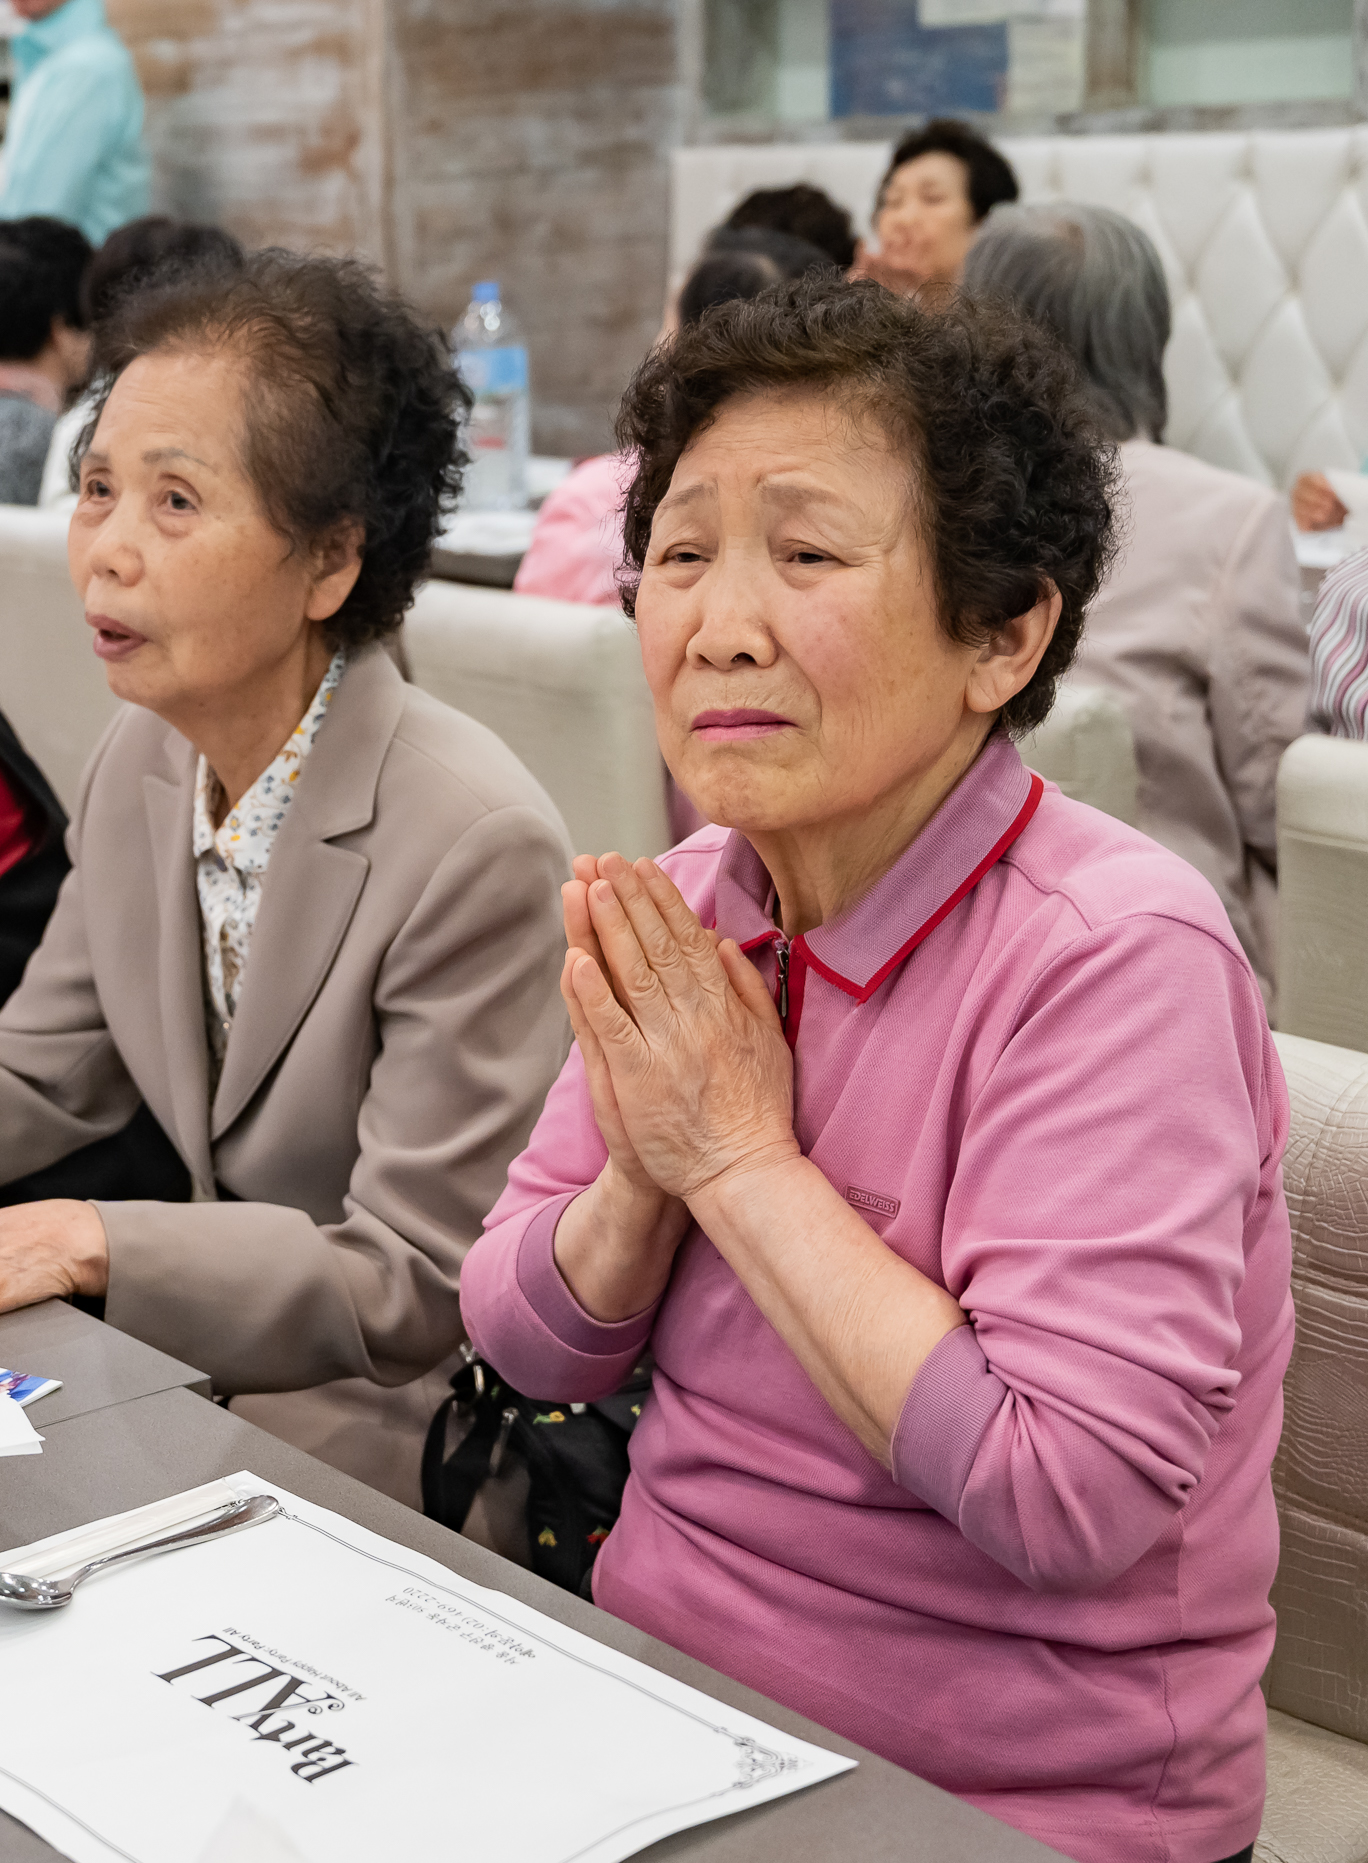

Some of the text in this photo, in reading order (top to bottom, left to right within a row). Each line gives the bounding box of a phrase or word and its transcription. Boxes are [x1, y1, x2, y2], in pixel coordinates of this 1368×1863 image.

[849, 1189, 895, 1213] EDELWEISS
[222, 1626, 241, 1636] All
[238, 1633, 266, 1650] Party
[149, 1633, 346, 1716] ALL
[227, 1702, 361, 1787] Party
